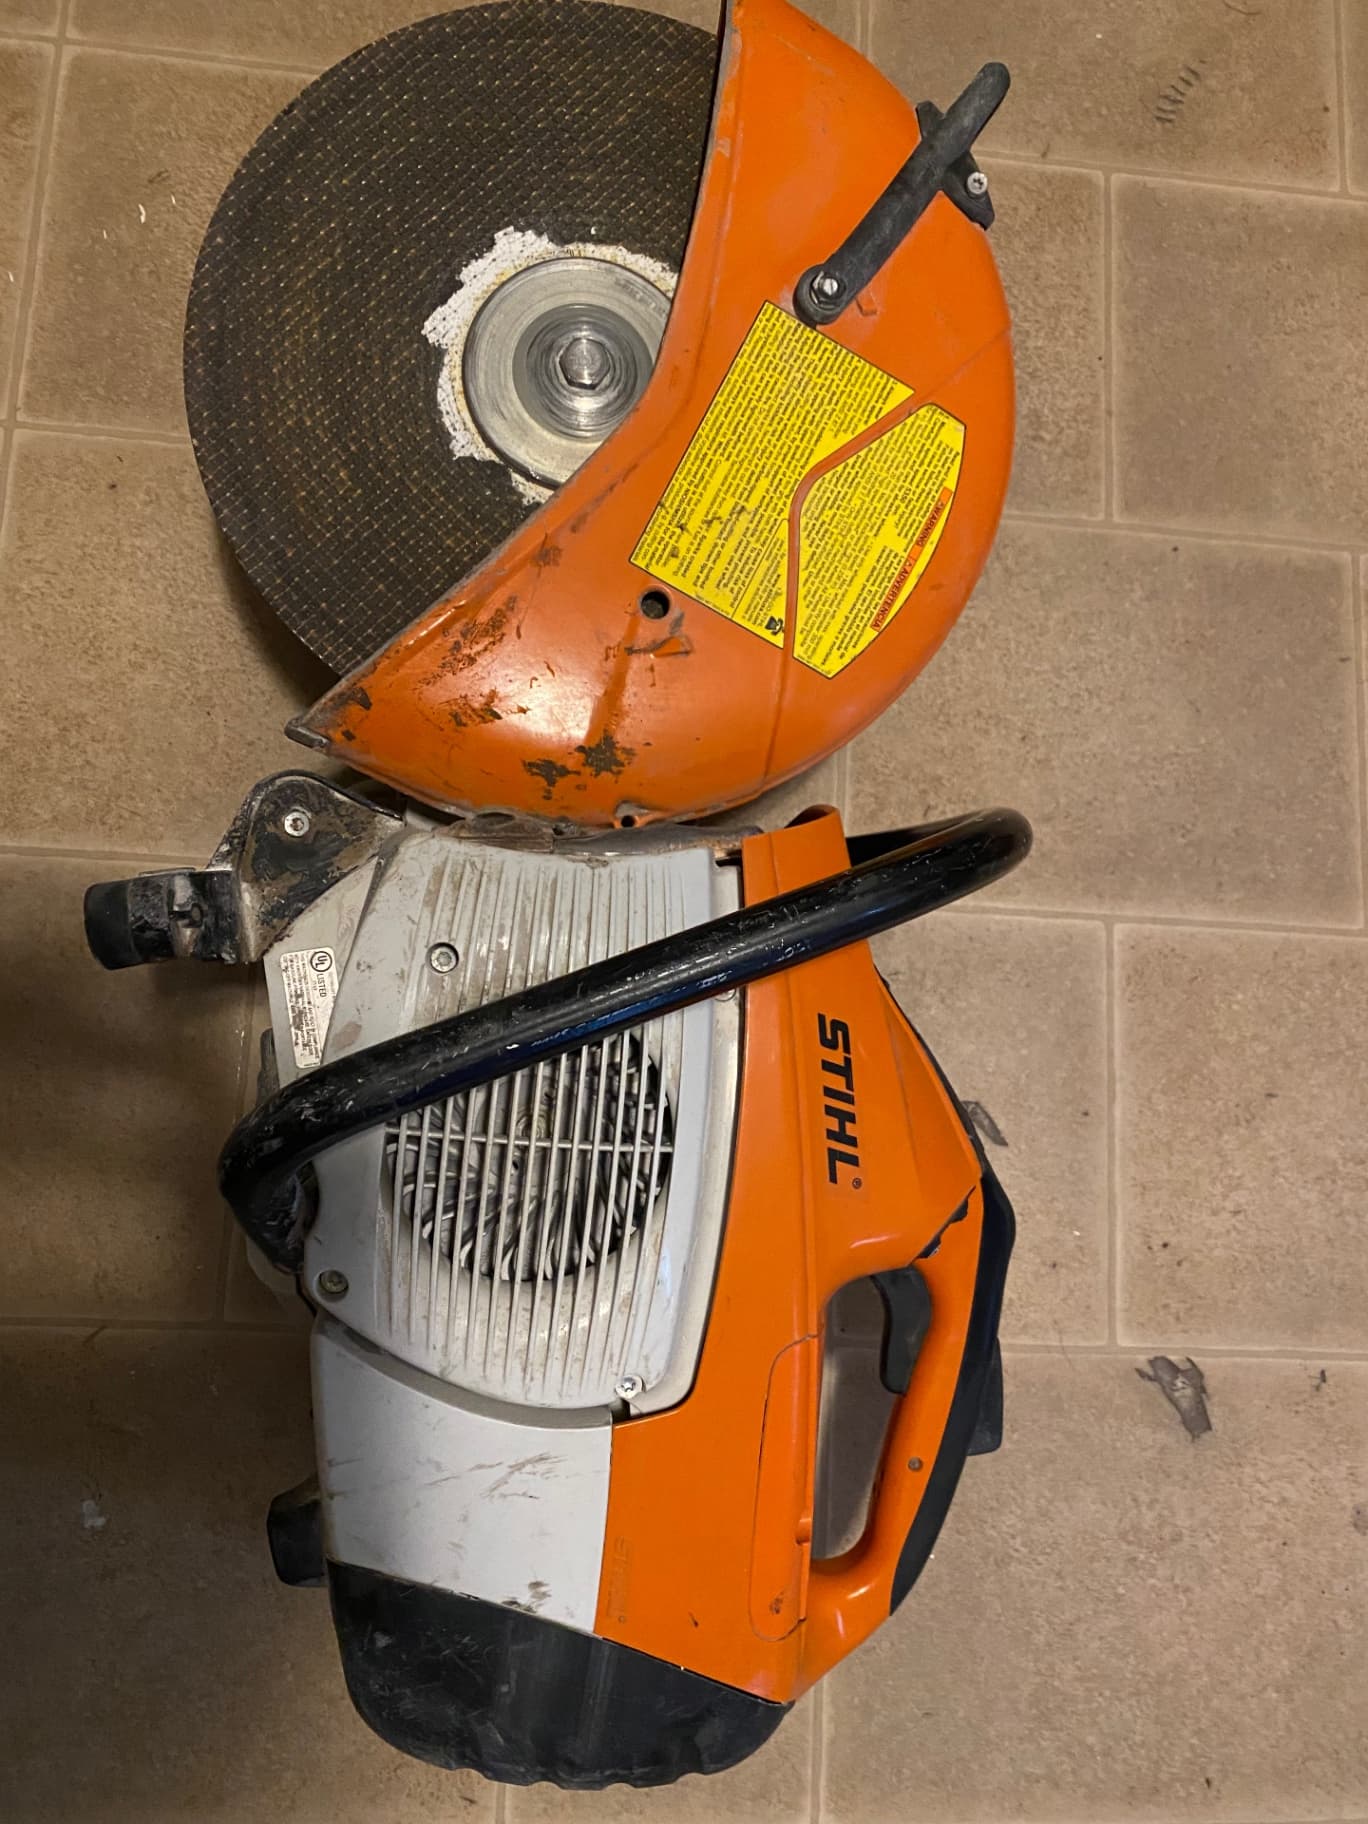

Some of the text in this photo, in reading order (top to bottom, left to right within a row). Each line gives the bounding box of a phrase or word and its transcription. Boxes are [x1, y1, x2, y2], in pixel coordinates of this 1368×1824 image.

[915, 505, 942, 547] WARNING
[871, 567, 909, 628] ADVERTENCIA
[316, 973, 327, 998] LISTED
[817, 1013, 859, 1184] STIHL
